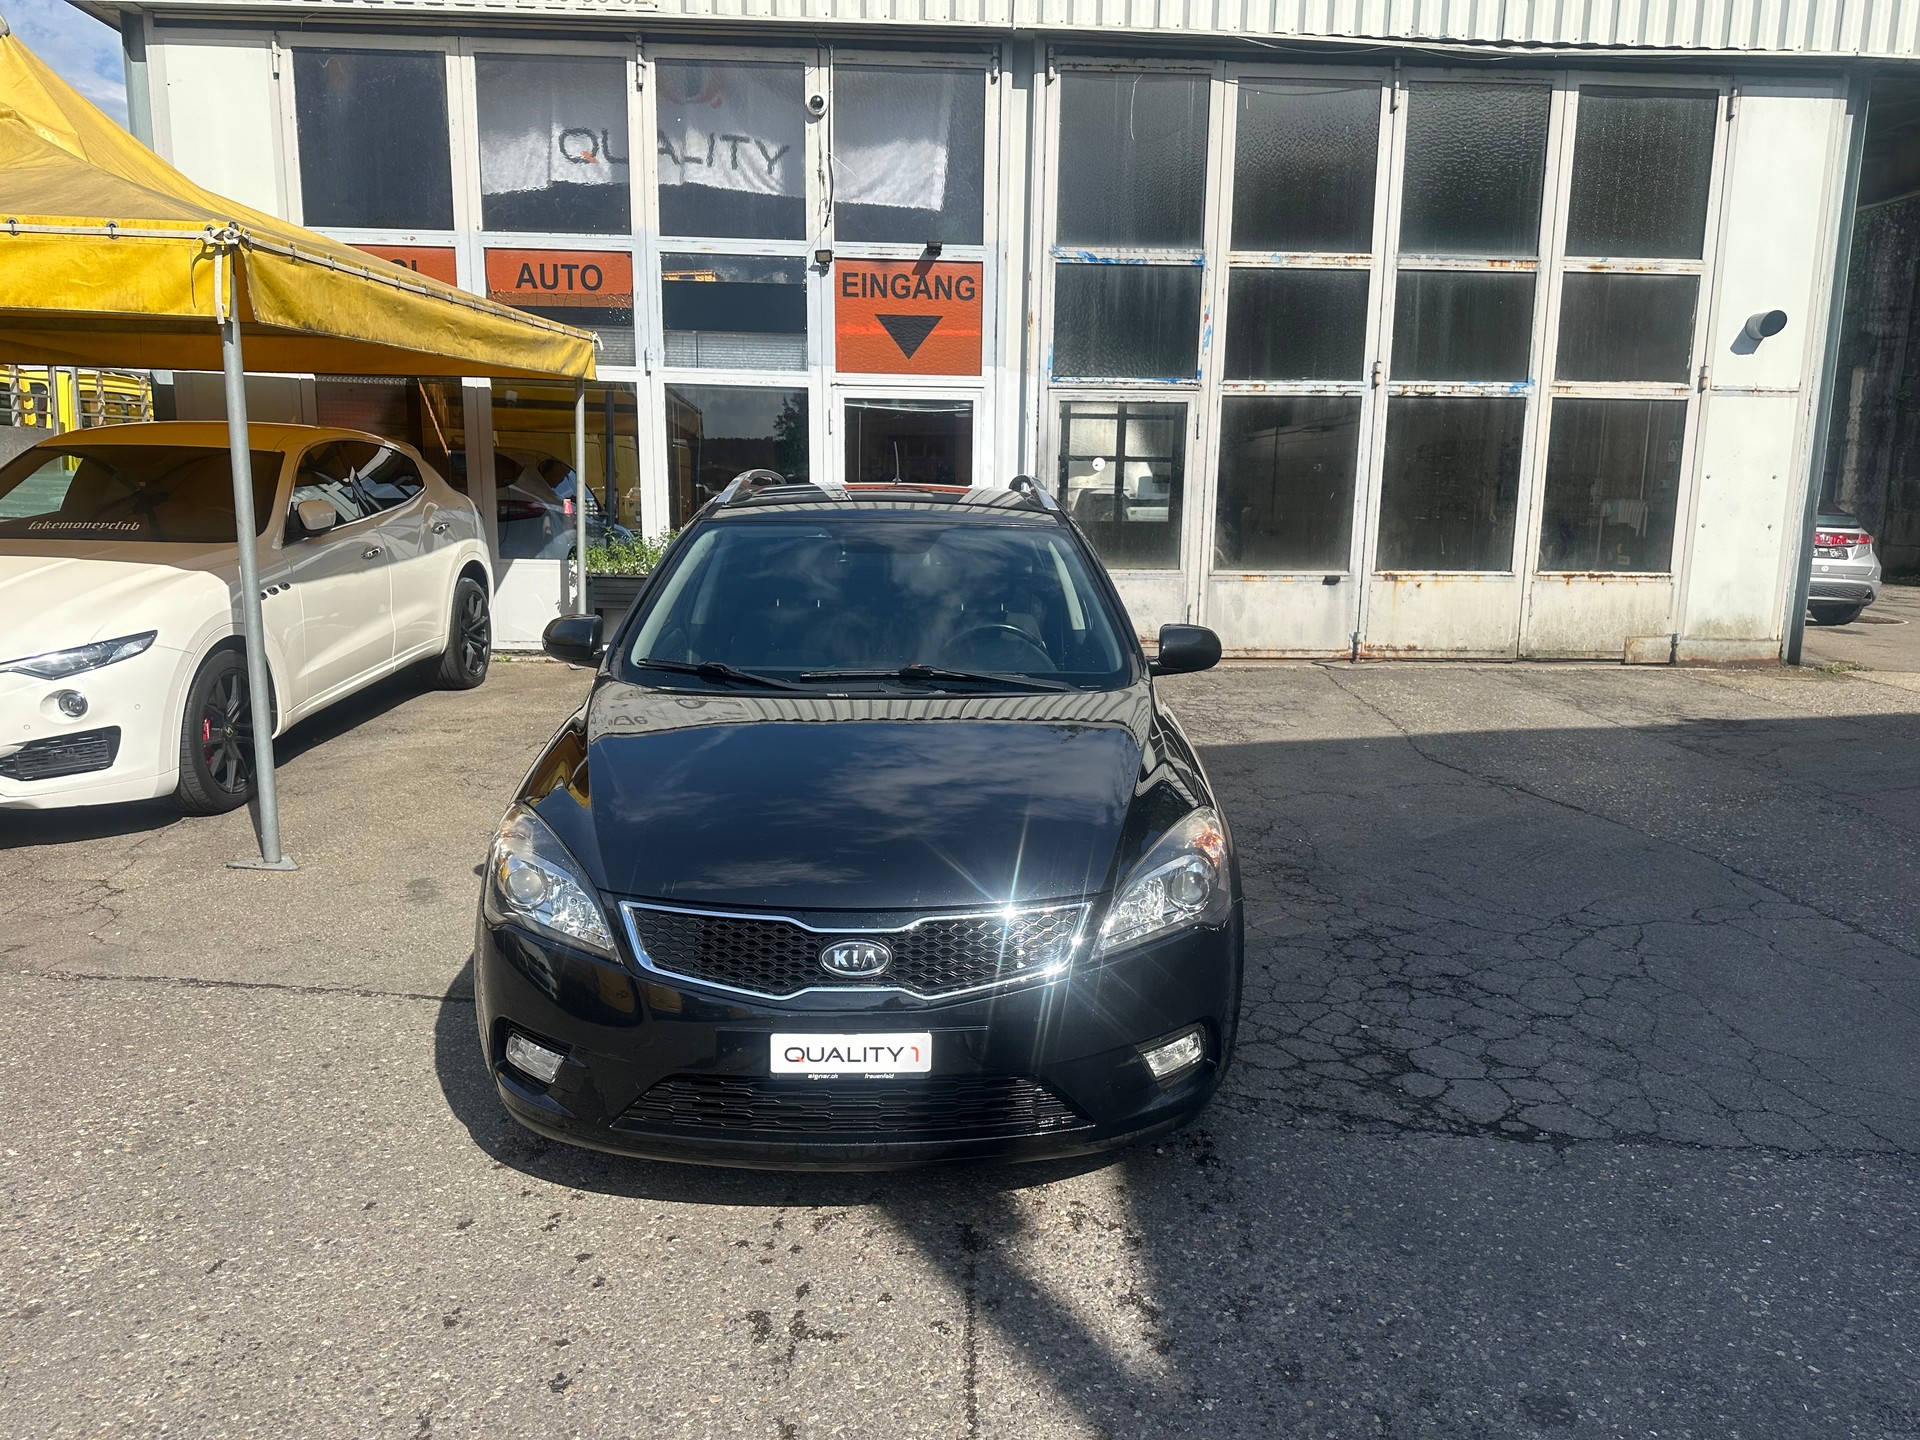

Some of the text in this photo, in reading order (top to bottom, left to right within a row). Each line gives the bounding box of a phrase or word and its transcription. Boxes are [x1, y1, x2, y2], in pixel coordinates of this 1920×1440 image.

[515, 262, 603, 291] AUTO
[842, 272, 976, 301] EINGANG
[27, 520, 141, 531] fakemoneyclub
[833, 949, 878, 969] KIA
